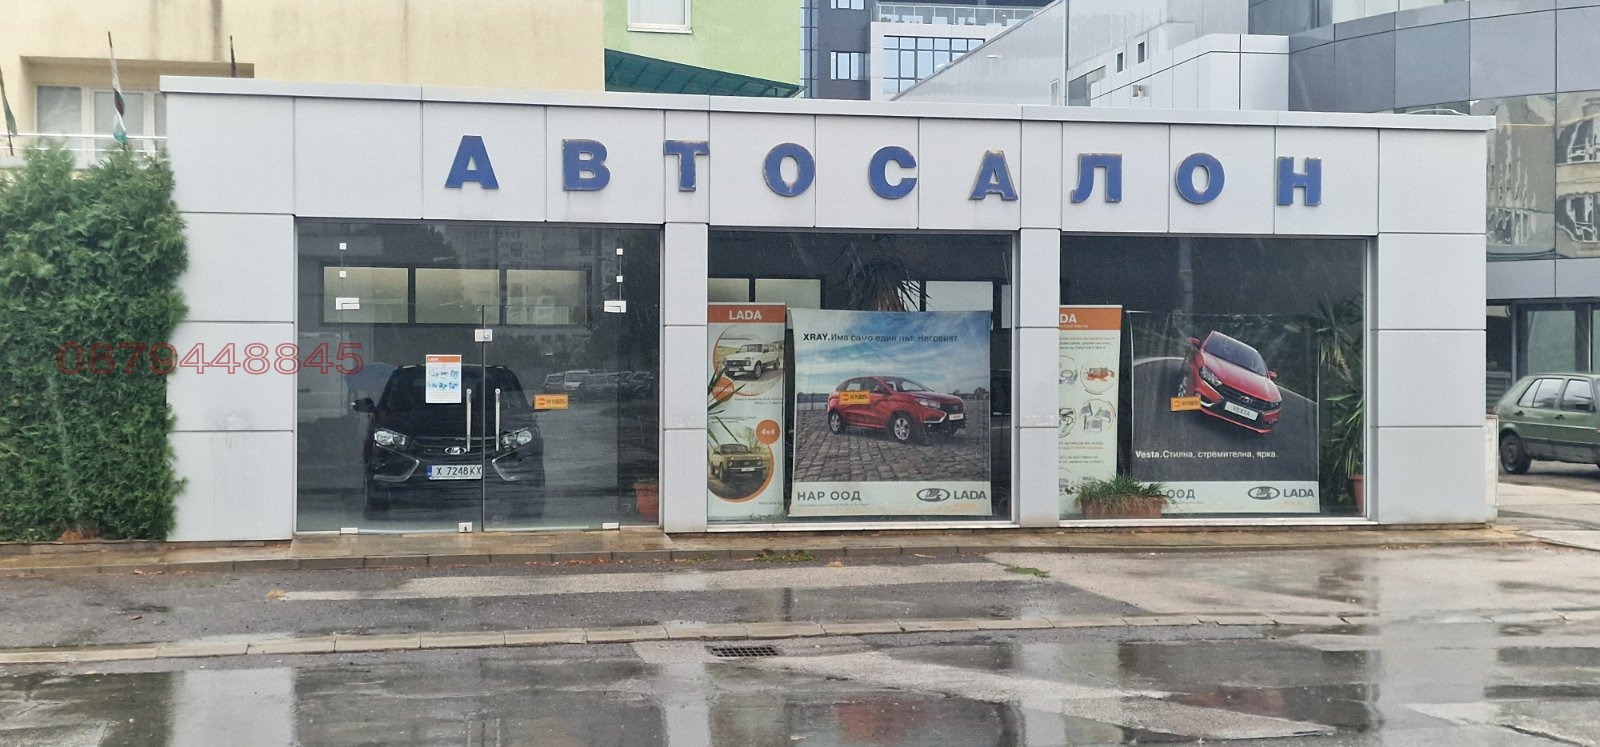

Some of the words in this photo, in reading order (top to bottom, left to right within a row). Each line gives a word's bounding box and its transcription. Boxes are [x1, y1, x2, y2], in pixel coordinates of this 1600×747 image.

[444, 134, 1323, 206] АВТОСАЛОН
[729, 310, 762, 320] LADA
[1060, 314, 1077, 323] DA
[761, 427, 775, 435] 4x4
[1197, 451, 1255, 459] стремителна,
[797, 491, 825, 501] НАР
[830, 490, 862, 502] ООД
[953, 490, 987, 500] LADA
[1166, 489, 1196, 500] ООД
[1283, 488, 1315, 498] LADA
